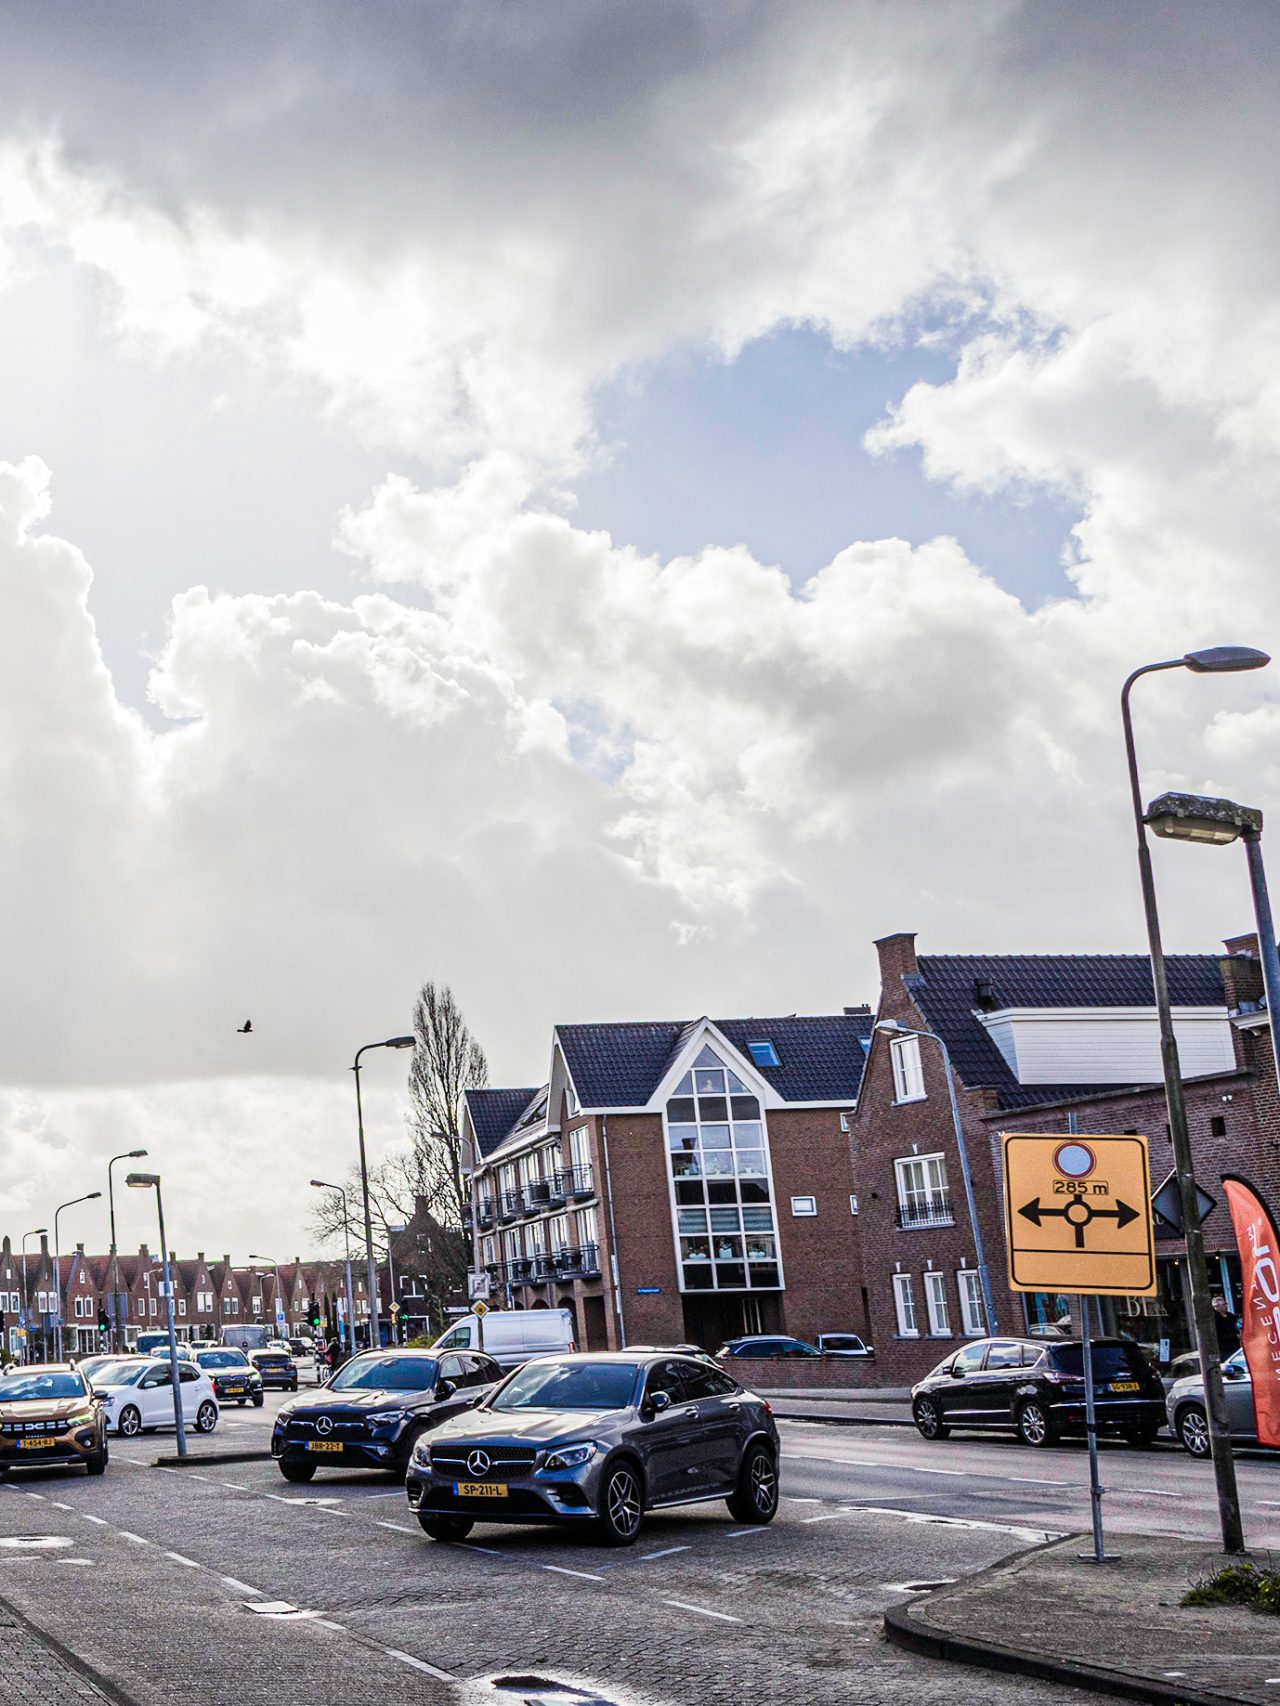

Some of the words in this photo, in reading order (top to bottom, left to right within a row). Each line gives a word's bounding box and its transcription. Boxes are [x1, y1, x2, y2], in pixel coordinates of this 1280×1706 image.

[1055, 1181, 1088, 1194] 285
[1093, 1184, 1107, 1194] m
[463, 1484, 503, 1496] SP-211-L
